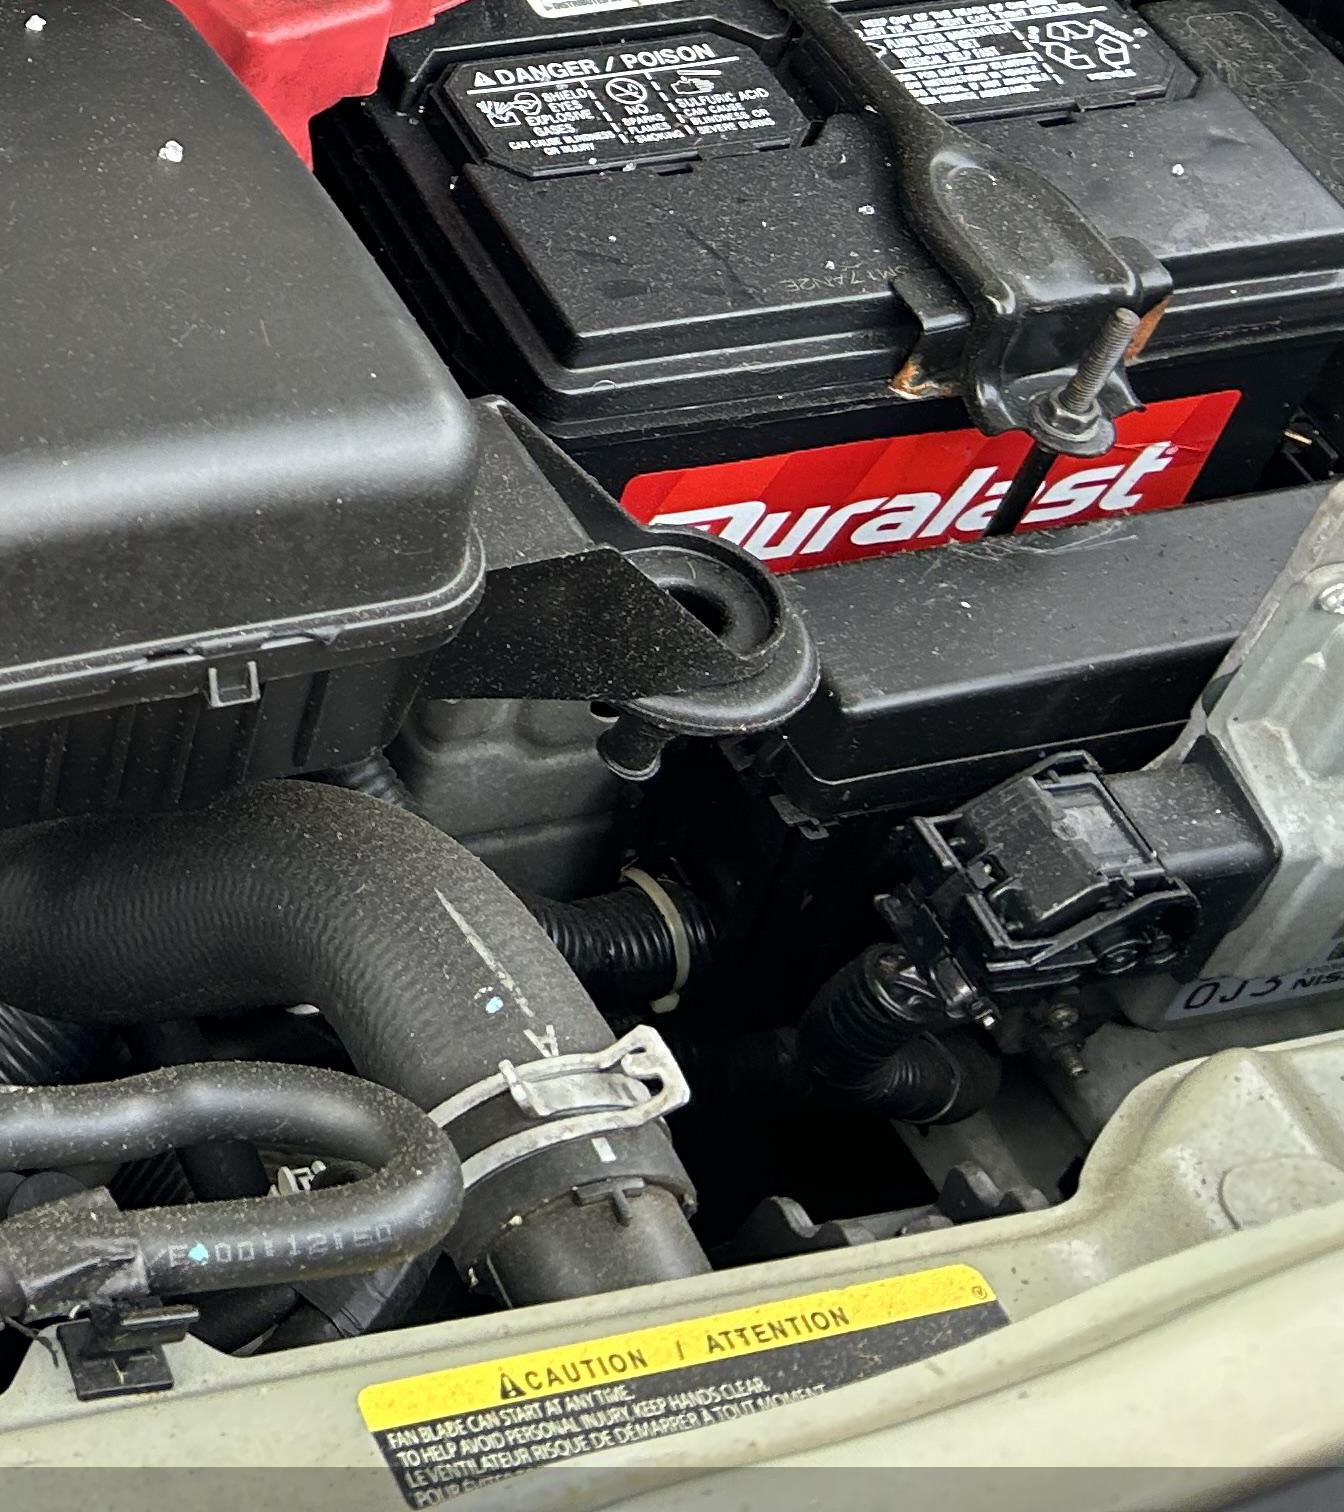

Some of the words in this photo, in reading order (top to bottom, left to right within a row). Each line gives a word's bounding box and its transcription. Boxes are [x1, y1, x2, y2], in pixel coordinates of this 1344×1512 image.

[494, 58, 601, 85] DANGER
[605, 55, 614, 72] /
[620, 43, 716, 69] POISON
[541, 88, 588, 103] SHIELD
[674, 92, 737, 108] SULFURIC
[738, 87, 769, 101] ACID
[547, 99, 584, 113] EYES
[624, 104, 649, 115] NO
[683, 107, 708, 117] CAN
[708, 102, 745, 113] CAUSE
[524, 108, 595, 127] EXPLOSIVE
[622, 113, 666, 127] SPARKS
[689, 111, 750, 126] BLINDNESS
[752, 108, 770, 118] OR
[533, 123, 576, 137] GASES
[627, 121, 671, 135] FLAMES
[696, 122, 738, 135] SEVERE
[737, 117, 776, 129] BURNS
[634, 129, 685, 144] SMOKING
[508, 140, 530, 150] CAN
[543, 146, 561, 156] OR
[651, 440, 1172, 561] Duralast
[524, 1349, 649, 1391] CAUTION
[705, 1306, 851, 1355] ATTENTION
[386, 1431, 419, 1449] FAN
[417, 1419, 467, 1444] BLADE
[465, 1411, 501, 1432] CAN
[499, 1402, 544, 1426] START
[543, 1398, 563, 1416] AT
[563, 1390, 595, 1413] ANY
[593, 1384, 636, 1406] TIME.
[395, 1450, 421, 1468] TO
[421, 1441, 458, 1464] HELP
[461, 1433, 505, 1456] AVOID
[504, 1415, 583, 1445] PERSONAL
[631, 1396, 666, 1418] KEEP
[666, 1386, 721, 1411] HANDS
[720, 1375, 771, 1400] CLEAR.
[403, 1469, 425, 1488] LE
[424, 1448, 533, 1483] VENTILATEUR
[530, 1436, 591, 1461] RISQUE
[589, 1428, 615, 1448] DE
[714, 1398, 755, 1423] TOUT
